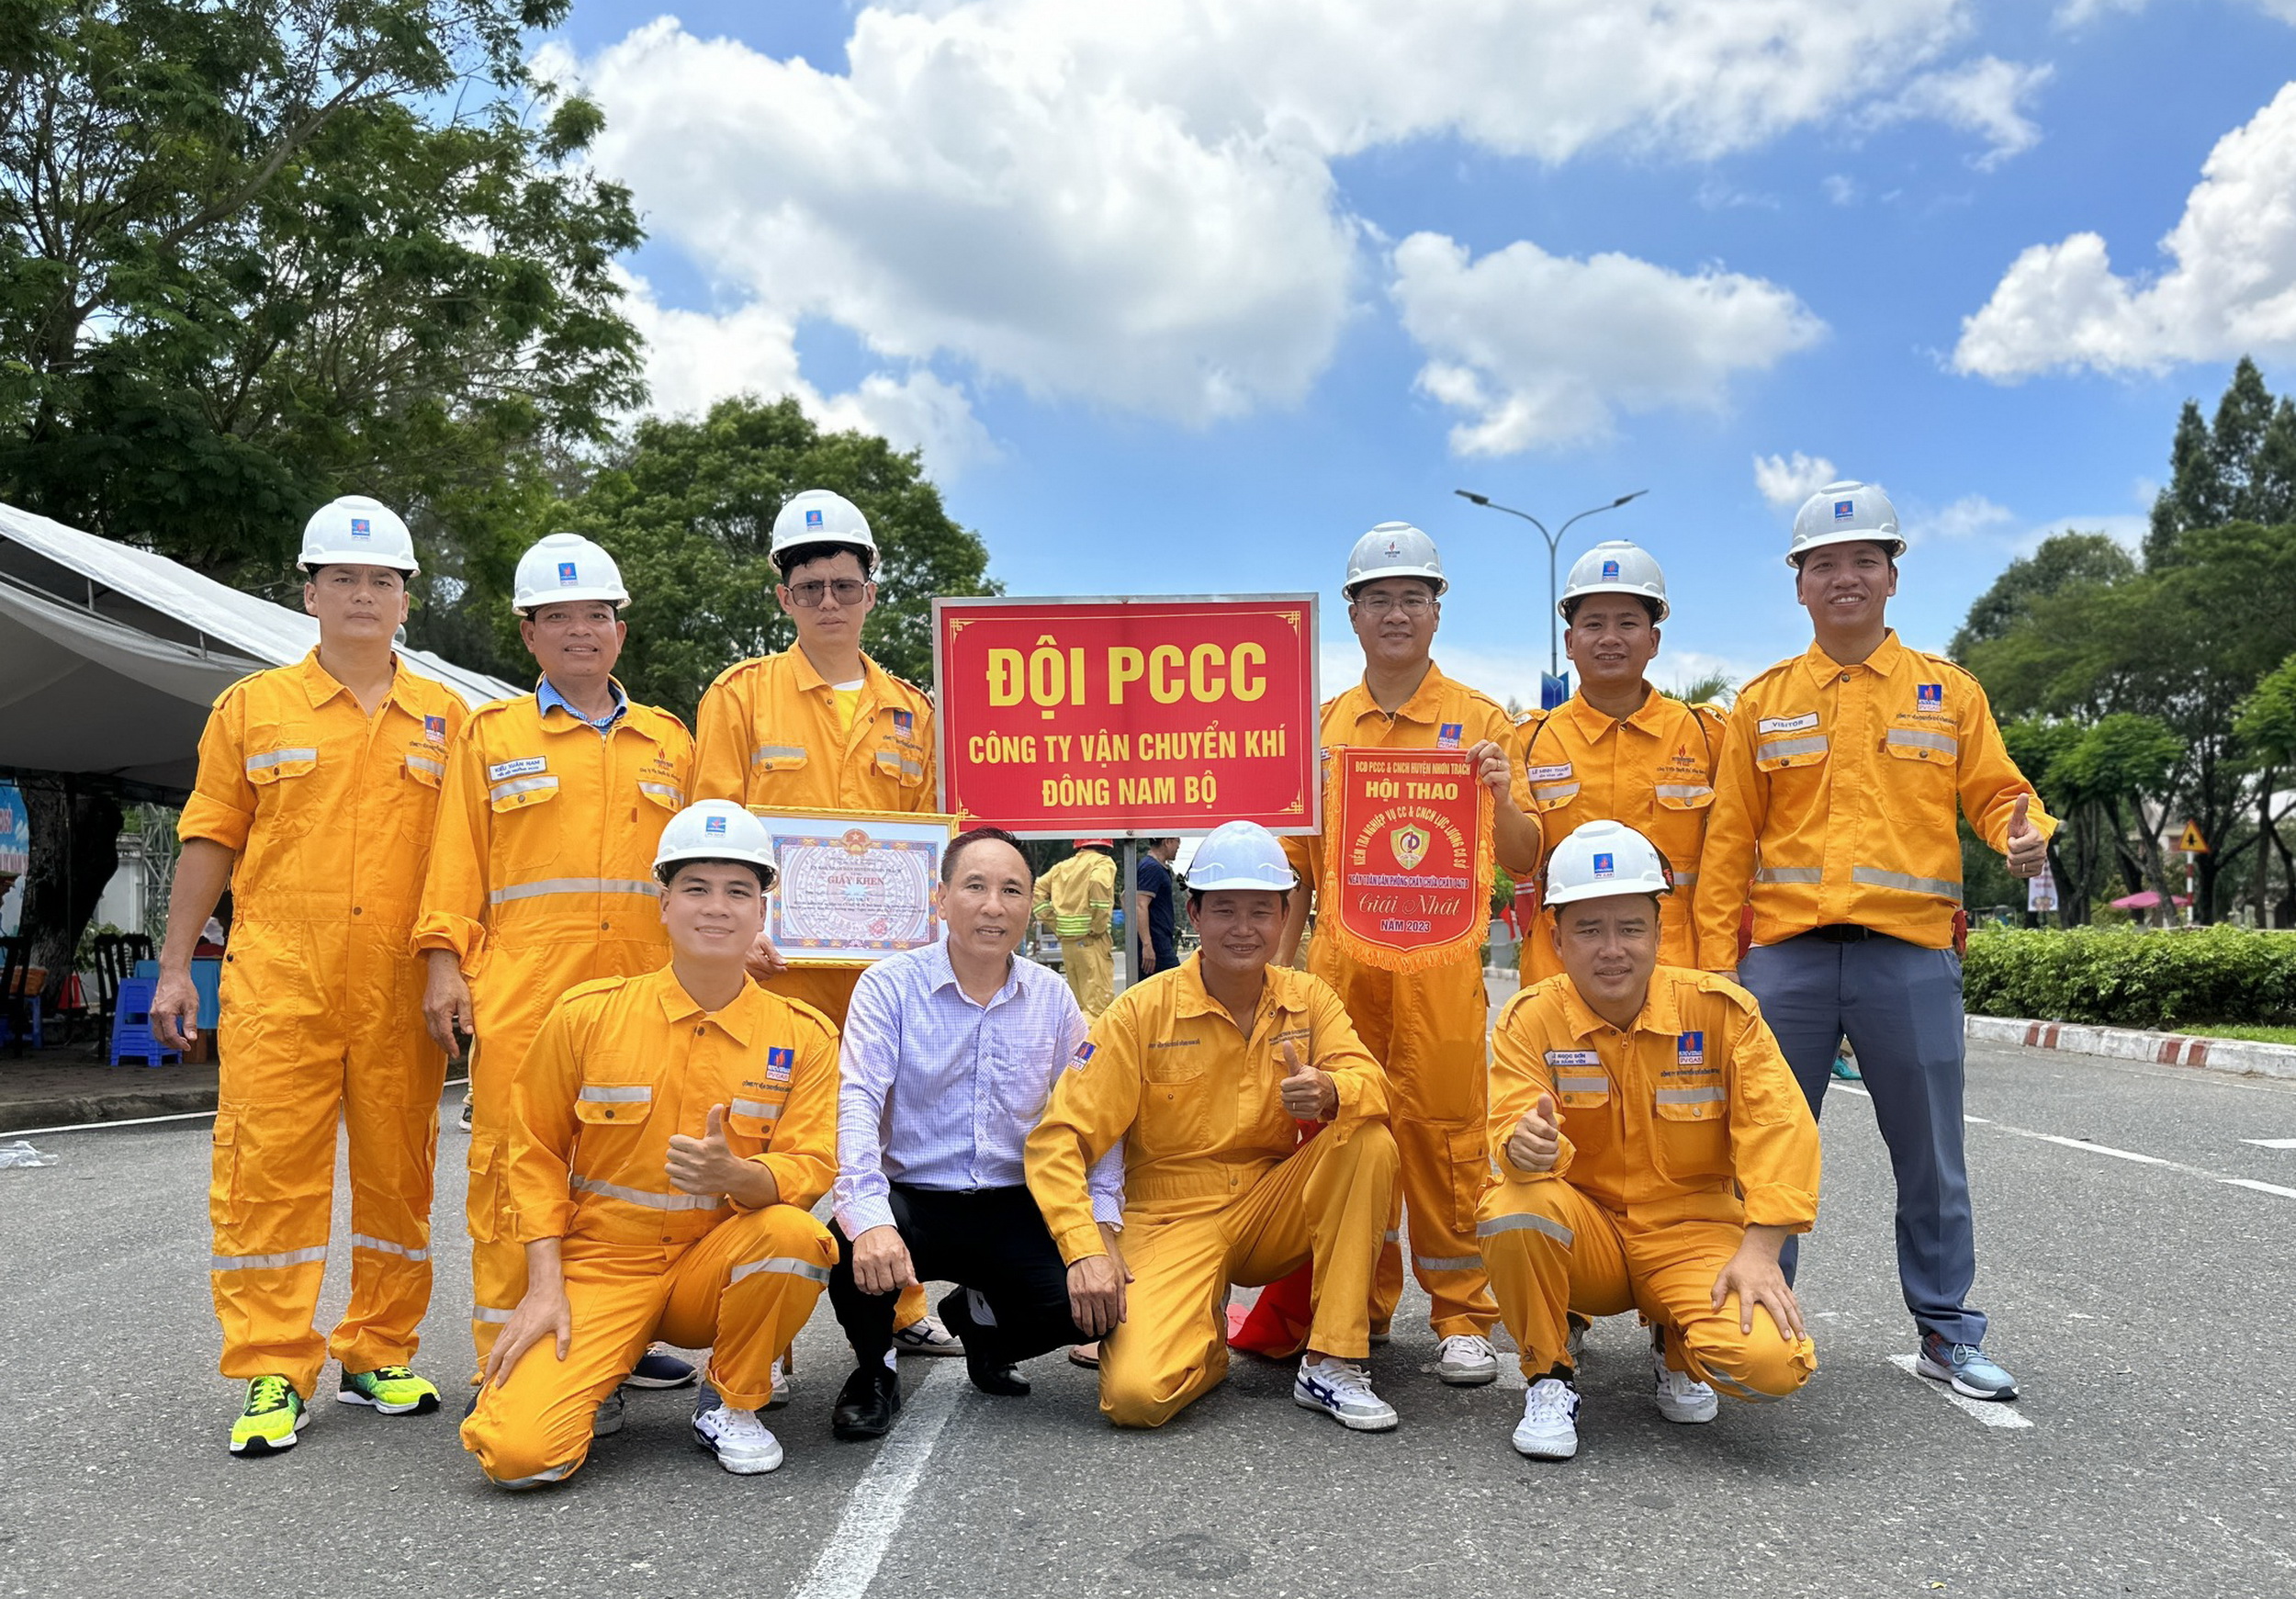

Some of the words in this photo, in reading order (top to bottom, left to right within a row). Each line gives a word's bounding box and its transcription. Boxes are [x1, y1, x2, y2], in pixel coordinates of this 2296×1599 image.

[985, 634, 1086, 720] ĐỘI
[1108, 641, 1266, 704] PCCC
[1773, 719, 1804, 727] VISITOR
[969, 730, 1036, 763] CÔNG
[1043, 735, 1073, 762] TY
[1080, 728, 1131, 768] VẬN
[1138, 719, 1236, 761] CHUYỂN
[1244, 723, 1286, 758] KHÍ
[1368, 761, 1386, 773] PCCC
[1386, 761, 1392, 773] &
[1392, 762, 1411, 774] CNCH
[1041, 773, 1110, 806] ĐÔNG
[1119, 777, 1176, 805] NAM
[1185, 770, 1217, 809] BỘ
[1366, 777, 1401, 802] HỘI
[1406, 782, 1458, 801] THAO
[1356, 834, 1371, 849] TRA
[1385, 807, 1397, 823] VỤ
[1396, 805, 1408, 818] CC
[1408, 805, 1415, 817] &
[1415, 805, 1437, 823] CNCH
[1434, 814, 1450, 829] LỰC
[1453, 848, 1469, 858] CƠ
[827, 873, 853, 885] GIẤY
[855, 875, 885, 886] KHEN
[1401, 895, 1460, 917] Nhất
[1380, 918, 1404, 932] NĂM
[1405, 919, 1431, 932] 2023
